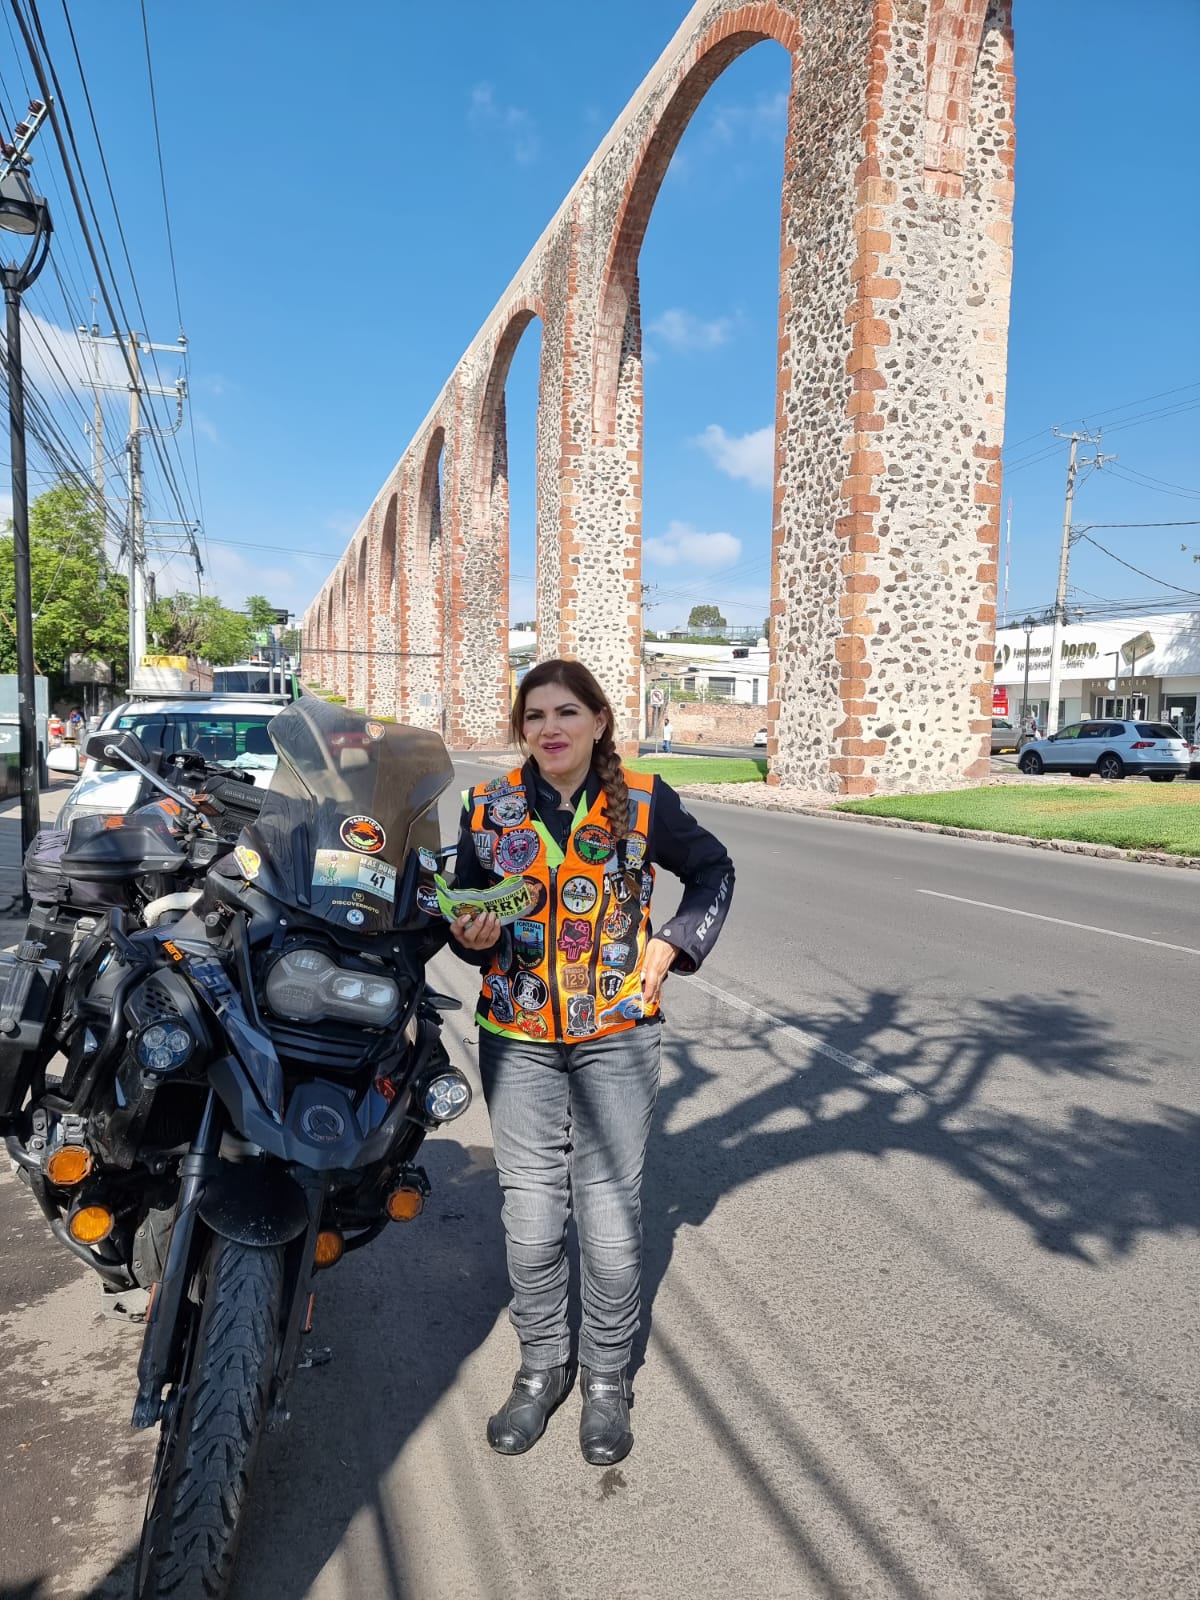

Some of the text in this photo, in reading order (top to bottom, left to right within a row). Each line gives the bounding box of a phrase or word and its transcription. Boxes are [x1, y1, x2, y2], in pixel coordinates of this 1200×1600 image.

[349, 817, 381, 831] TAMPICO
[370, 872, 386, 889] 41
[331, 899, 380, 914] DISCOVERMOTO
[485, 889, 529, 913] RRM
[565, 973, 585, 986] 129
